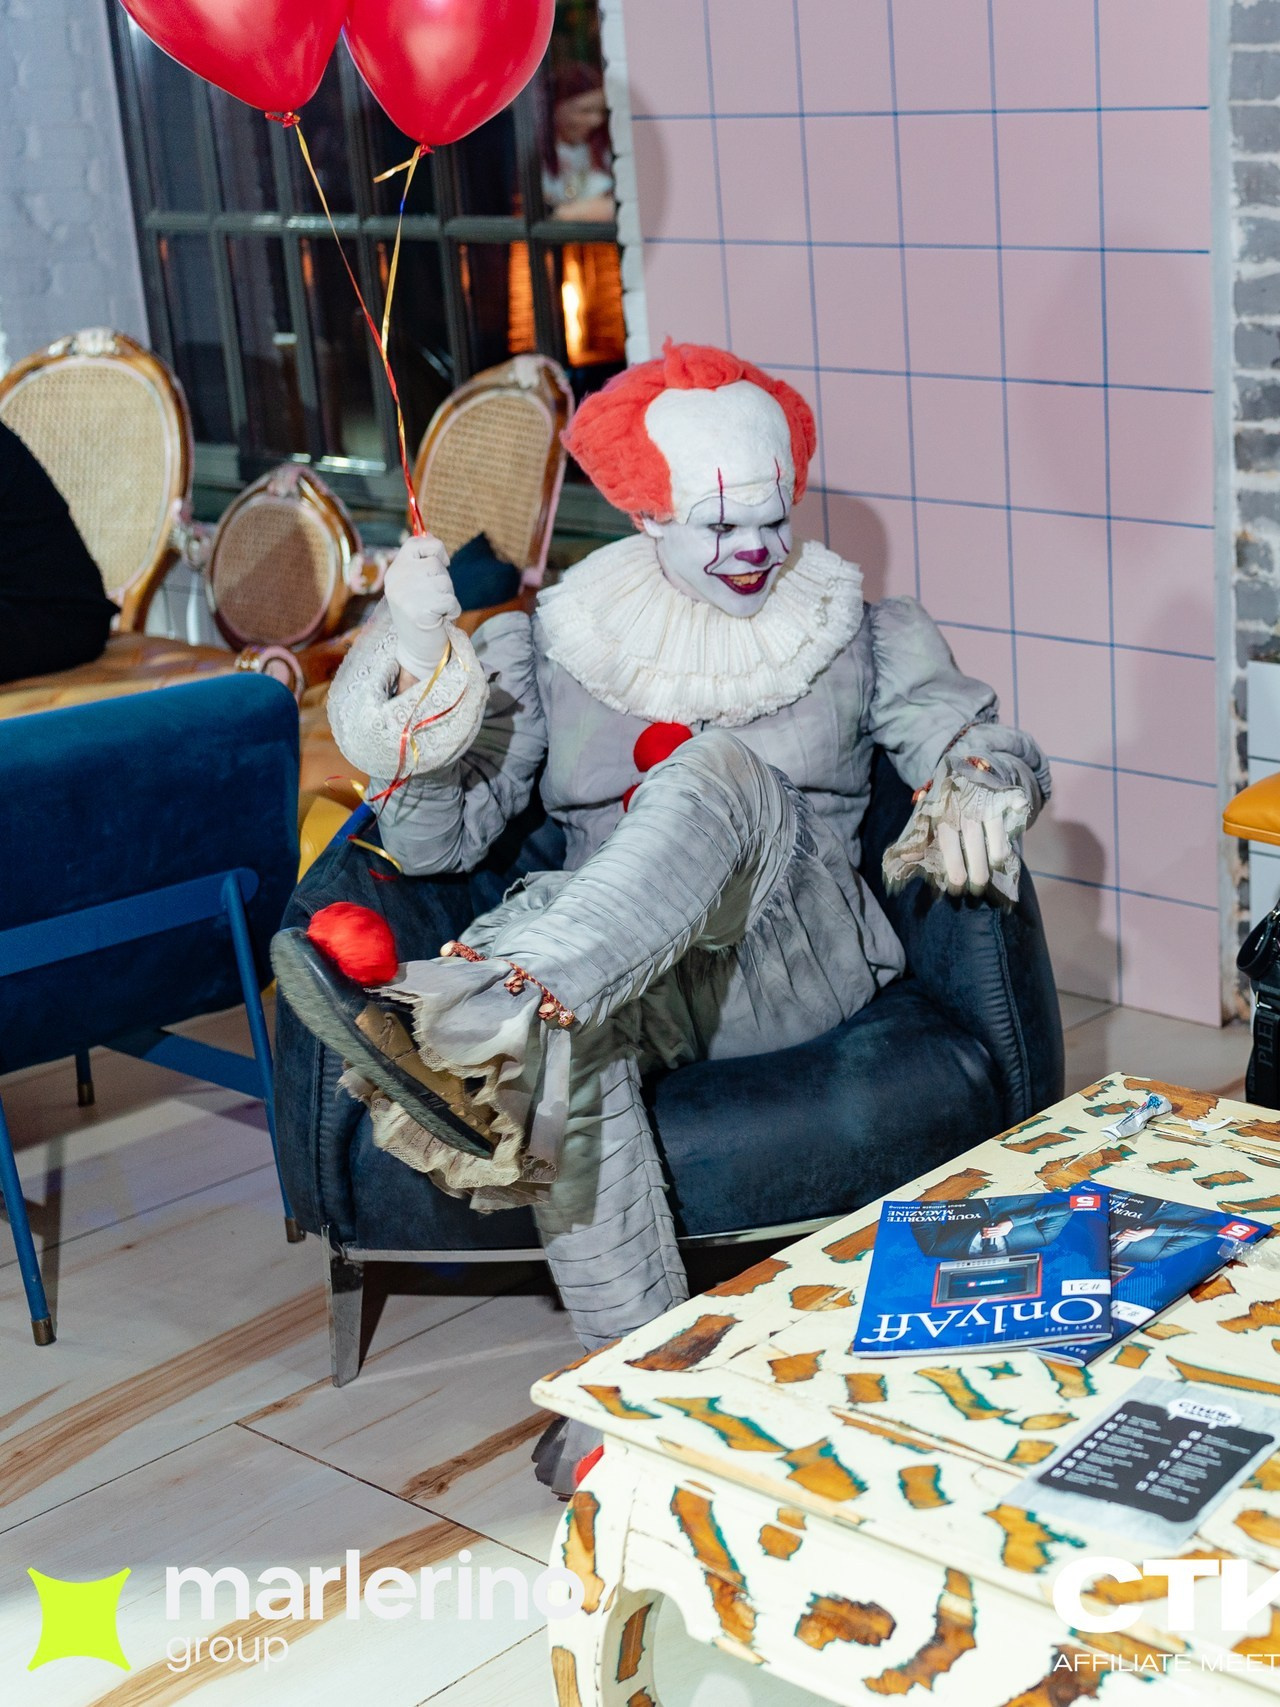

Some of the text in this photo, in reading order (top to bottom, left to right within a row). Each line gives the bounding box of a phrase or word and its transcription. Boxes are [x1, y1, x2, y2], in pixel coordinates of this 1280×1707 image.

[1076, 1196, 1095, 1206] 5
[1114, 1208, 1143, 1219] YOUR
[1226, 1224, 1250, 1237] 5
[1069, 1283, 1101, 1292] #21
[861, 1298, 1103, 1343] OnlyAff
